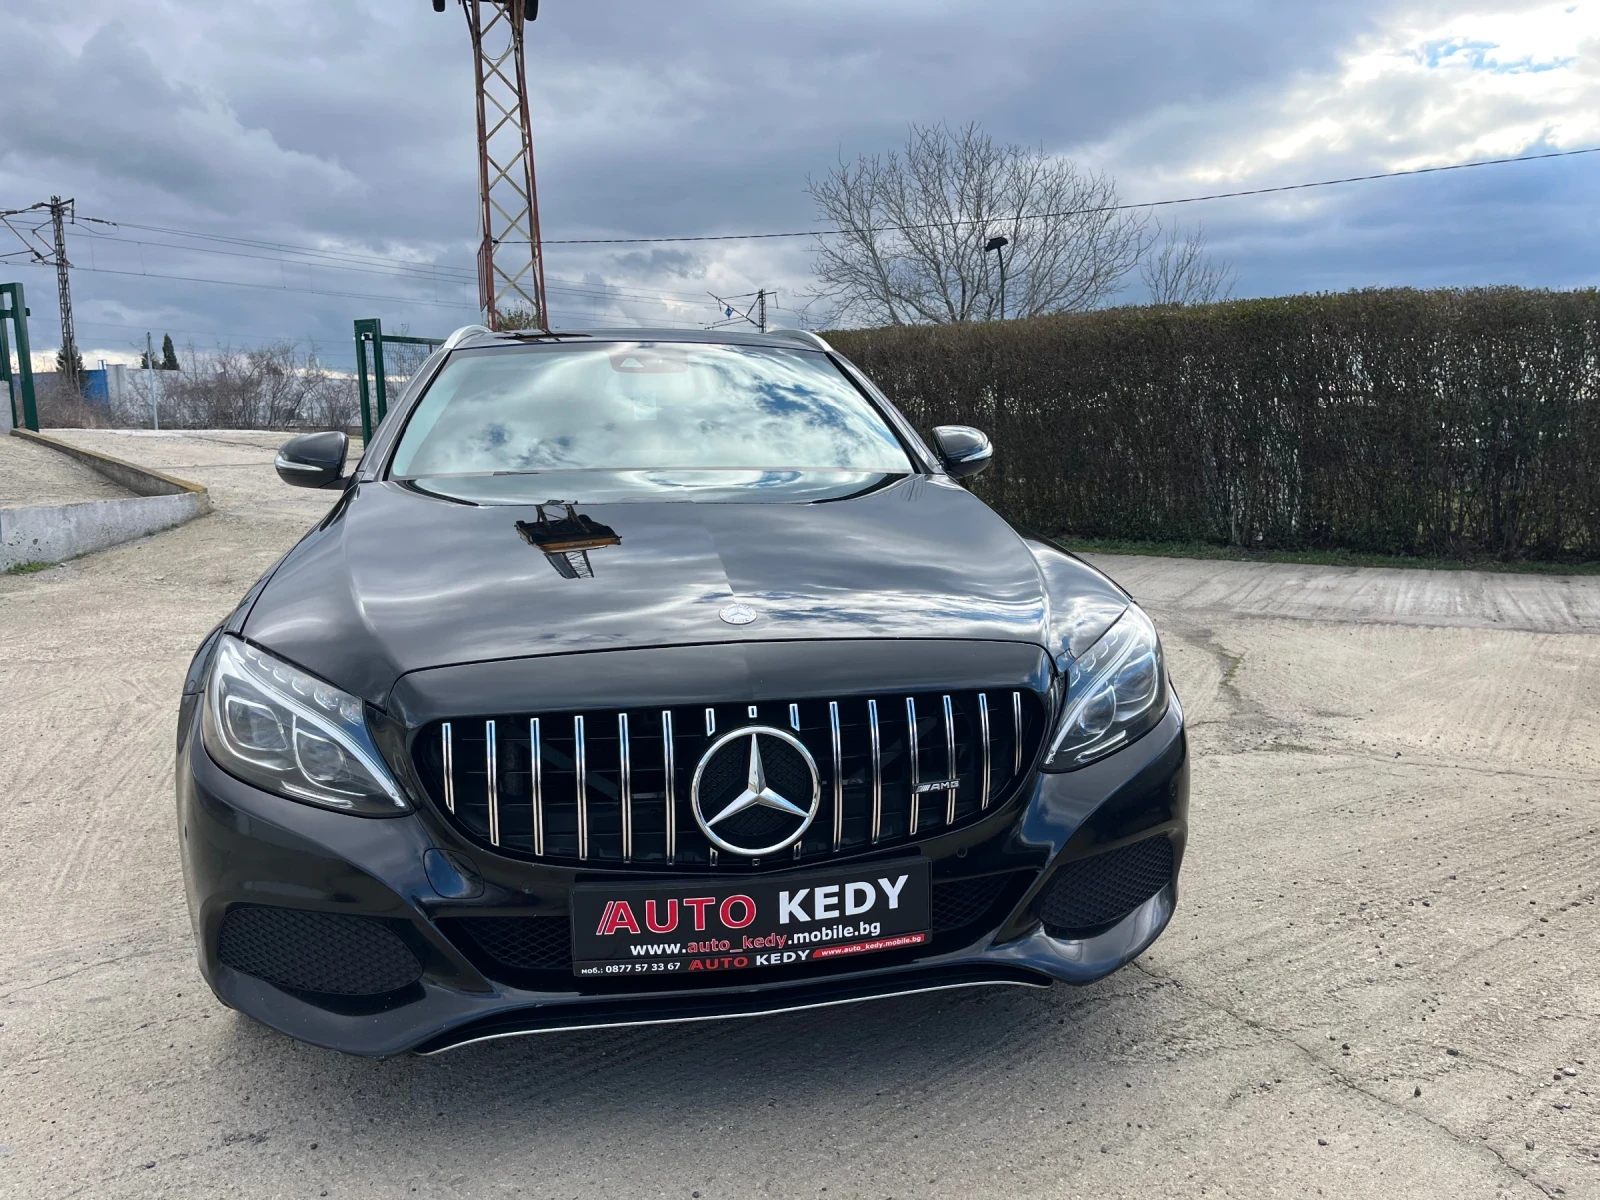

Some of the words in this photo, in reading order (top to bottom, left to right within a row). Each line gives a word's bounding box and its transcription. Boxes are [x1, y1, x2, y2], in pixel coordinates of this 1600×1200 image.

[929, 780, 959, 791] AMG
[596, 894, 757, 935] AUTO
[778, 874, 909, 925] KEDY
[630, 921, 881, 956] www.auto_kedy.mobile.bg
[821, 935, 922, 957] www.auto_kedy.mobile.bg
[605, 963, 631, 973] 0877
[635, 963, 648, 972] 57
[651, 963, 665, 971] 33
[667, 962, 681, 970] 67
[688, 956, 748, 971] AUTO
[756, 950, 810, 966] KEDY
